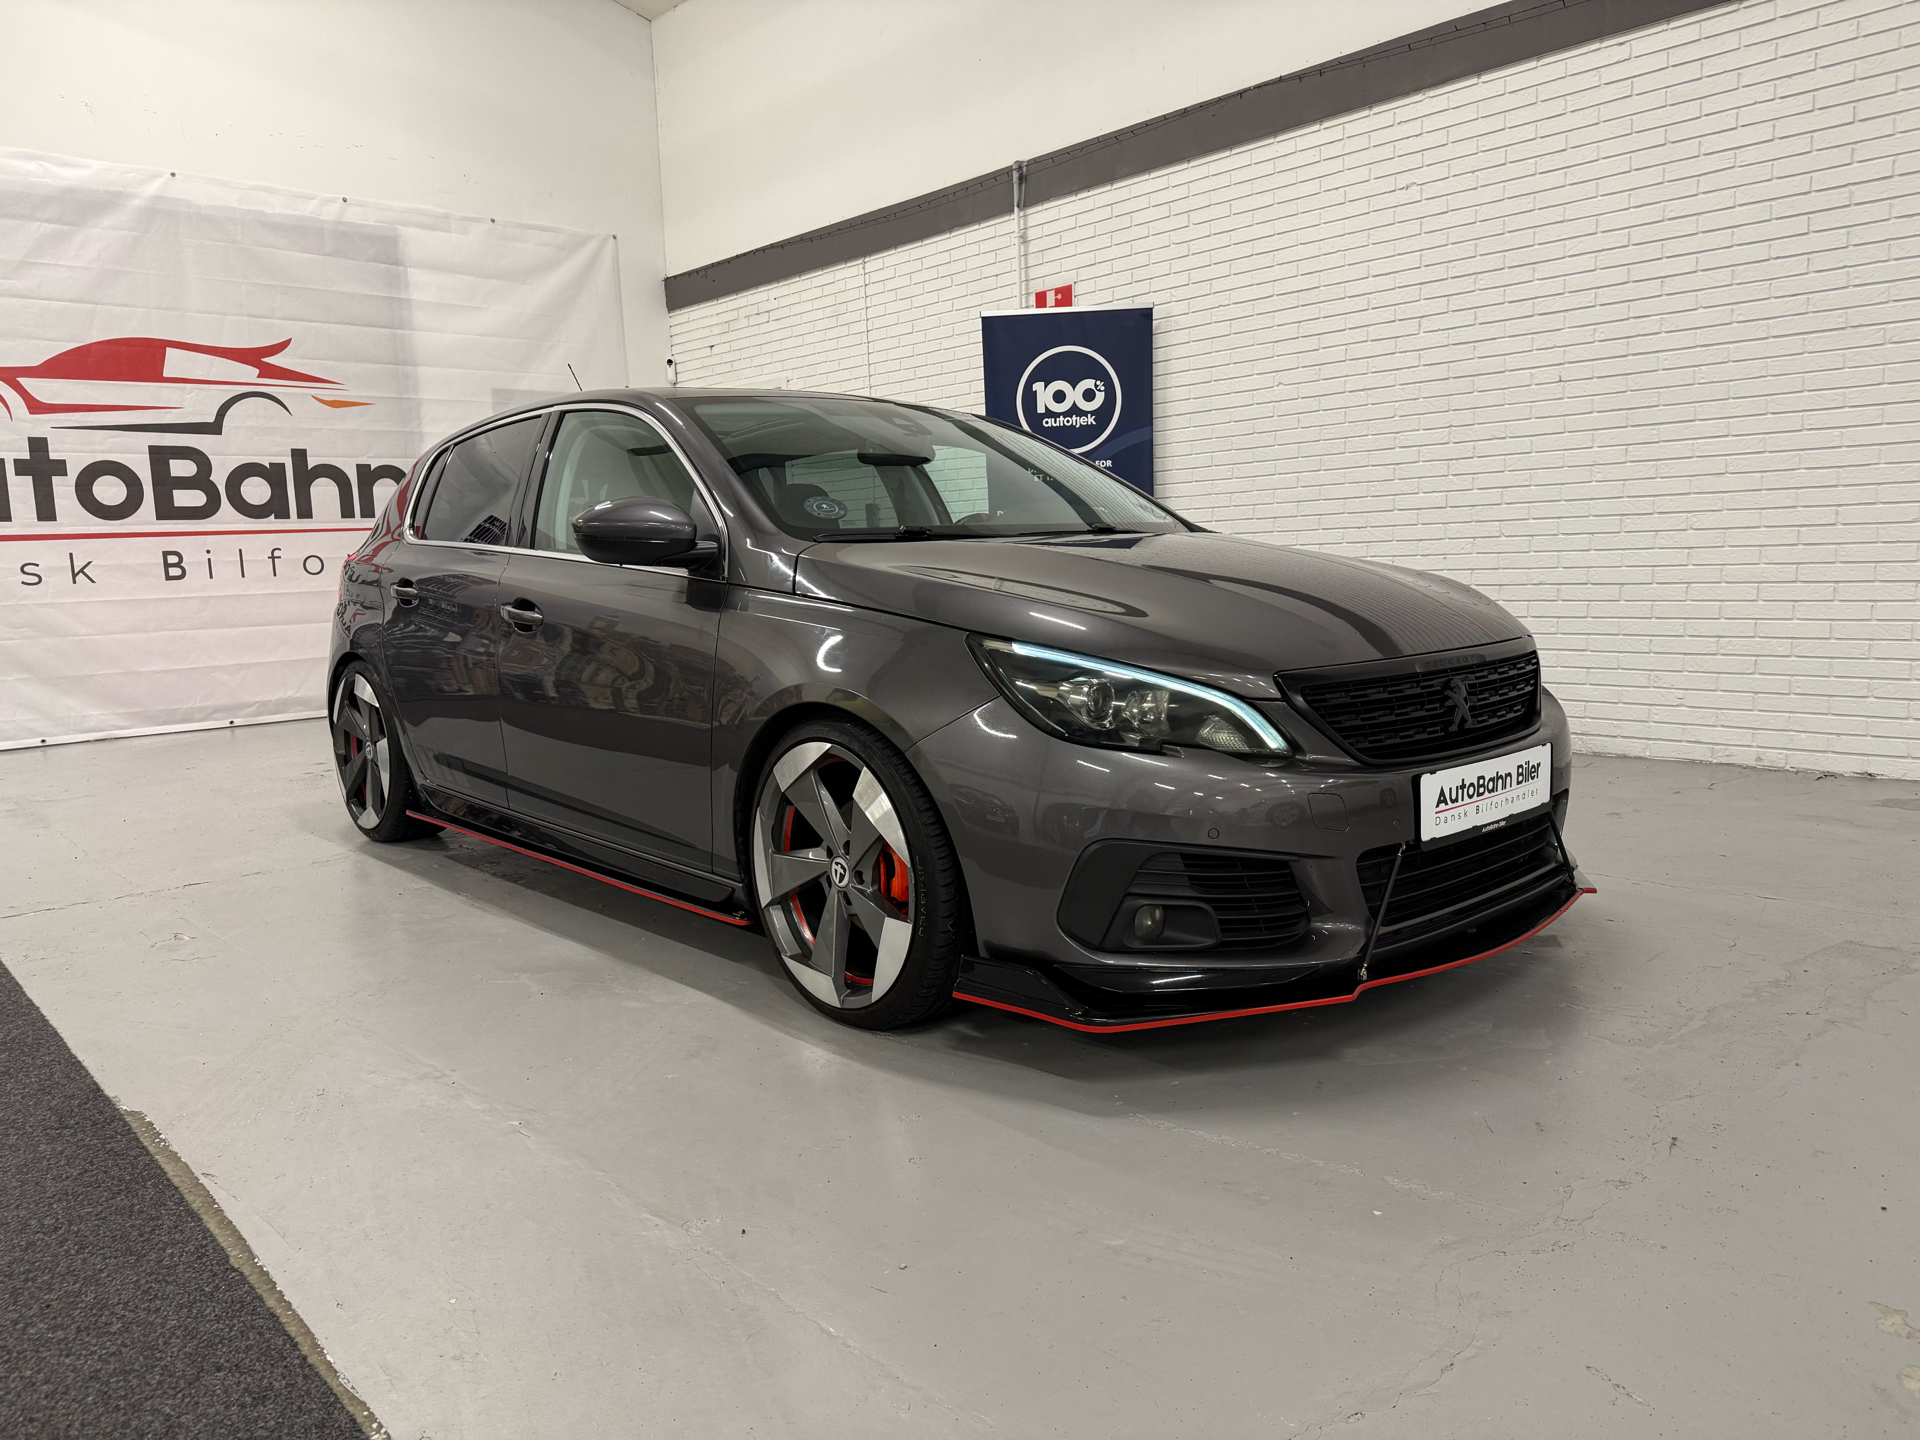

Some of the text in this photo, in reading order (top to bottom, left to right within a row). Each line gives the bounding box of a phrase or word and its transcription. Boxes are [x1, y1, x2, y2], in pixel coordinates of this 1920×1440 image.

[1032, 378, 1105, 414] 100%
[0, 437, 407, 522] toBahn
[161, 547, 351, 582] Bilfo
[1434, 760, 1541, 809] AutoBahn Biler
[1434, 787, 1539, 826] Dansk Bilforhandler
